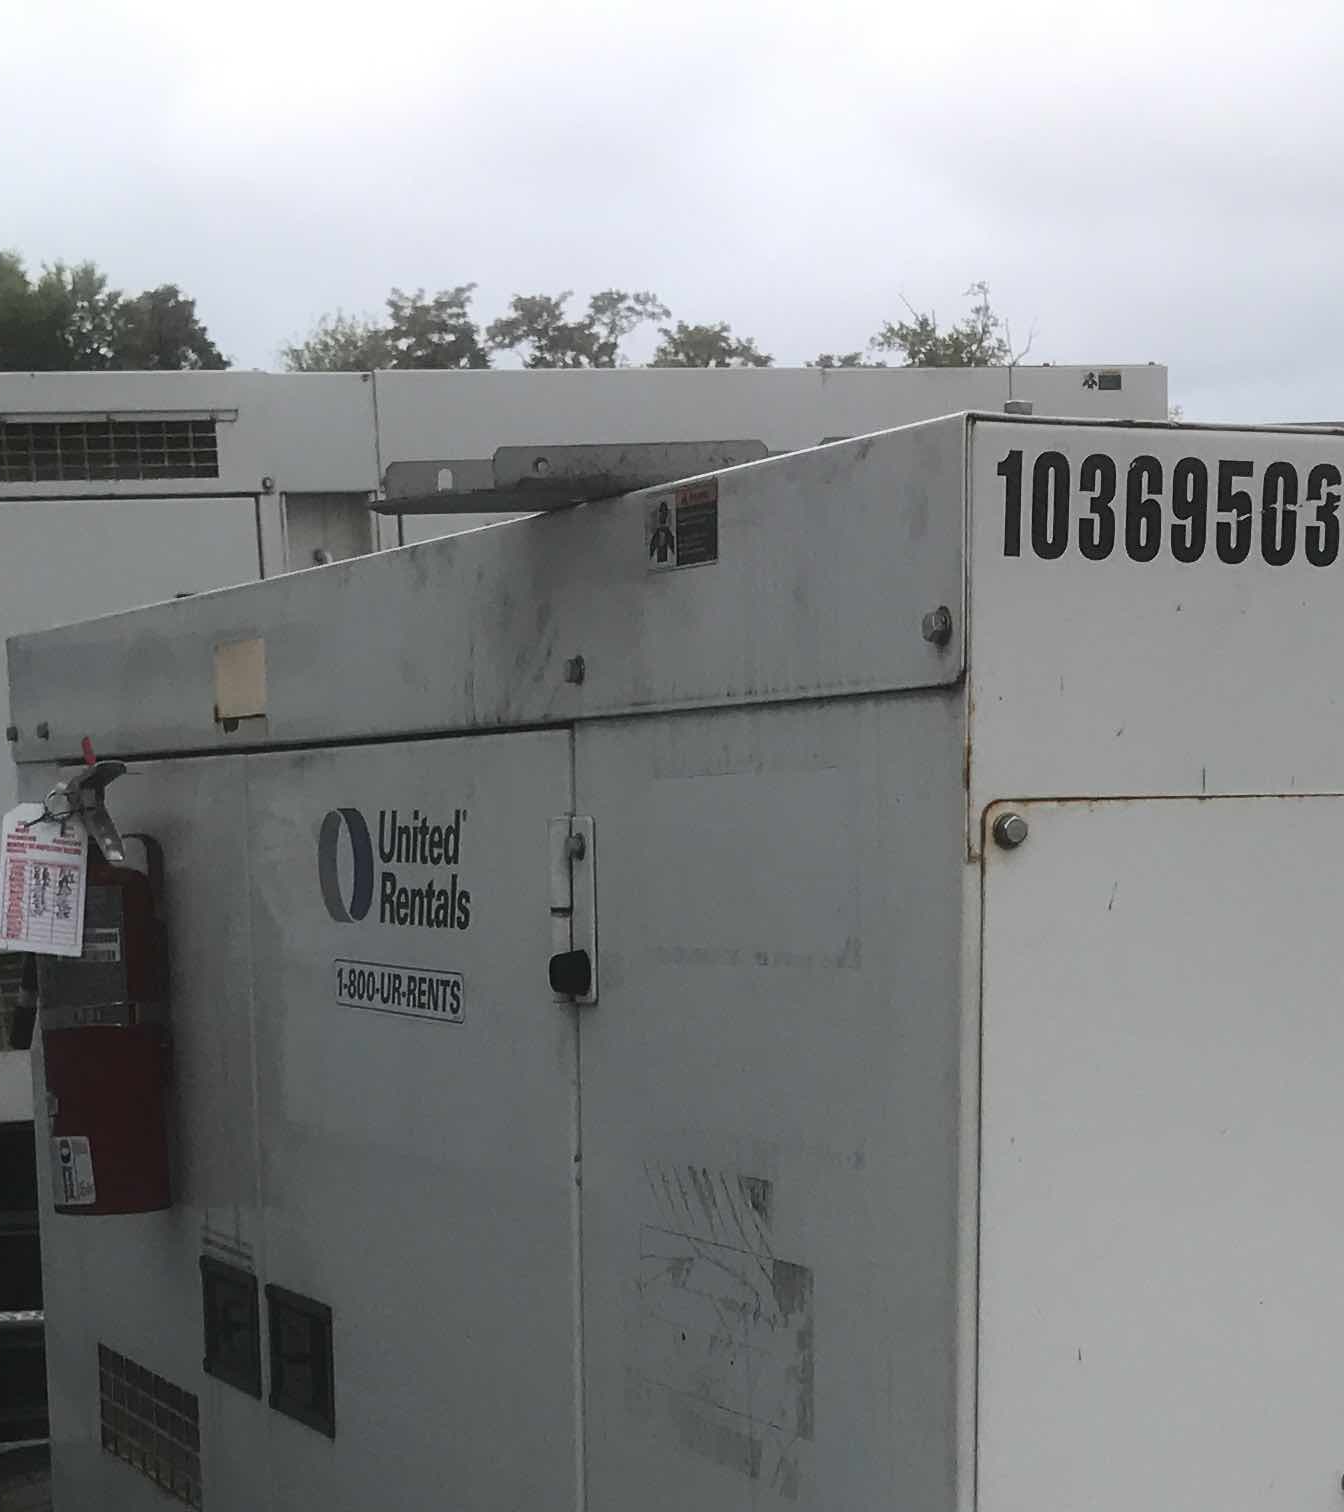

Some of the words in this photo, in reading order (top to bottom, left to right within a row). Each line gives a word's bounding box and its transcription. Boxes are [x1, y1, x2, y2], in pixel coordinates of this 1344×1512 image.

[996, 450, 1343, 567] 10369503
[378, 809, 461, 865] United
[379, 871, 471, 930] Rentals
[336, 967, 461, 1015] 1-800-UR-RENTS
